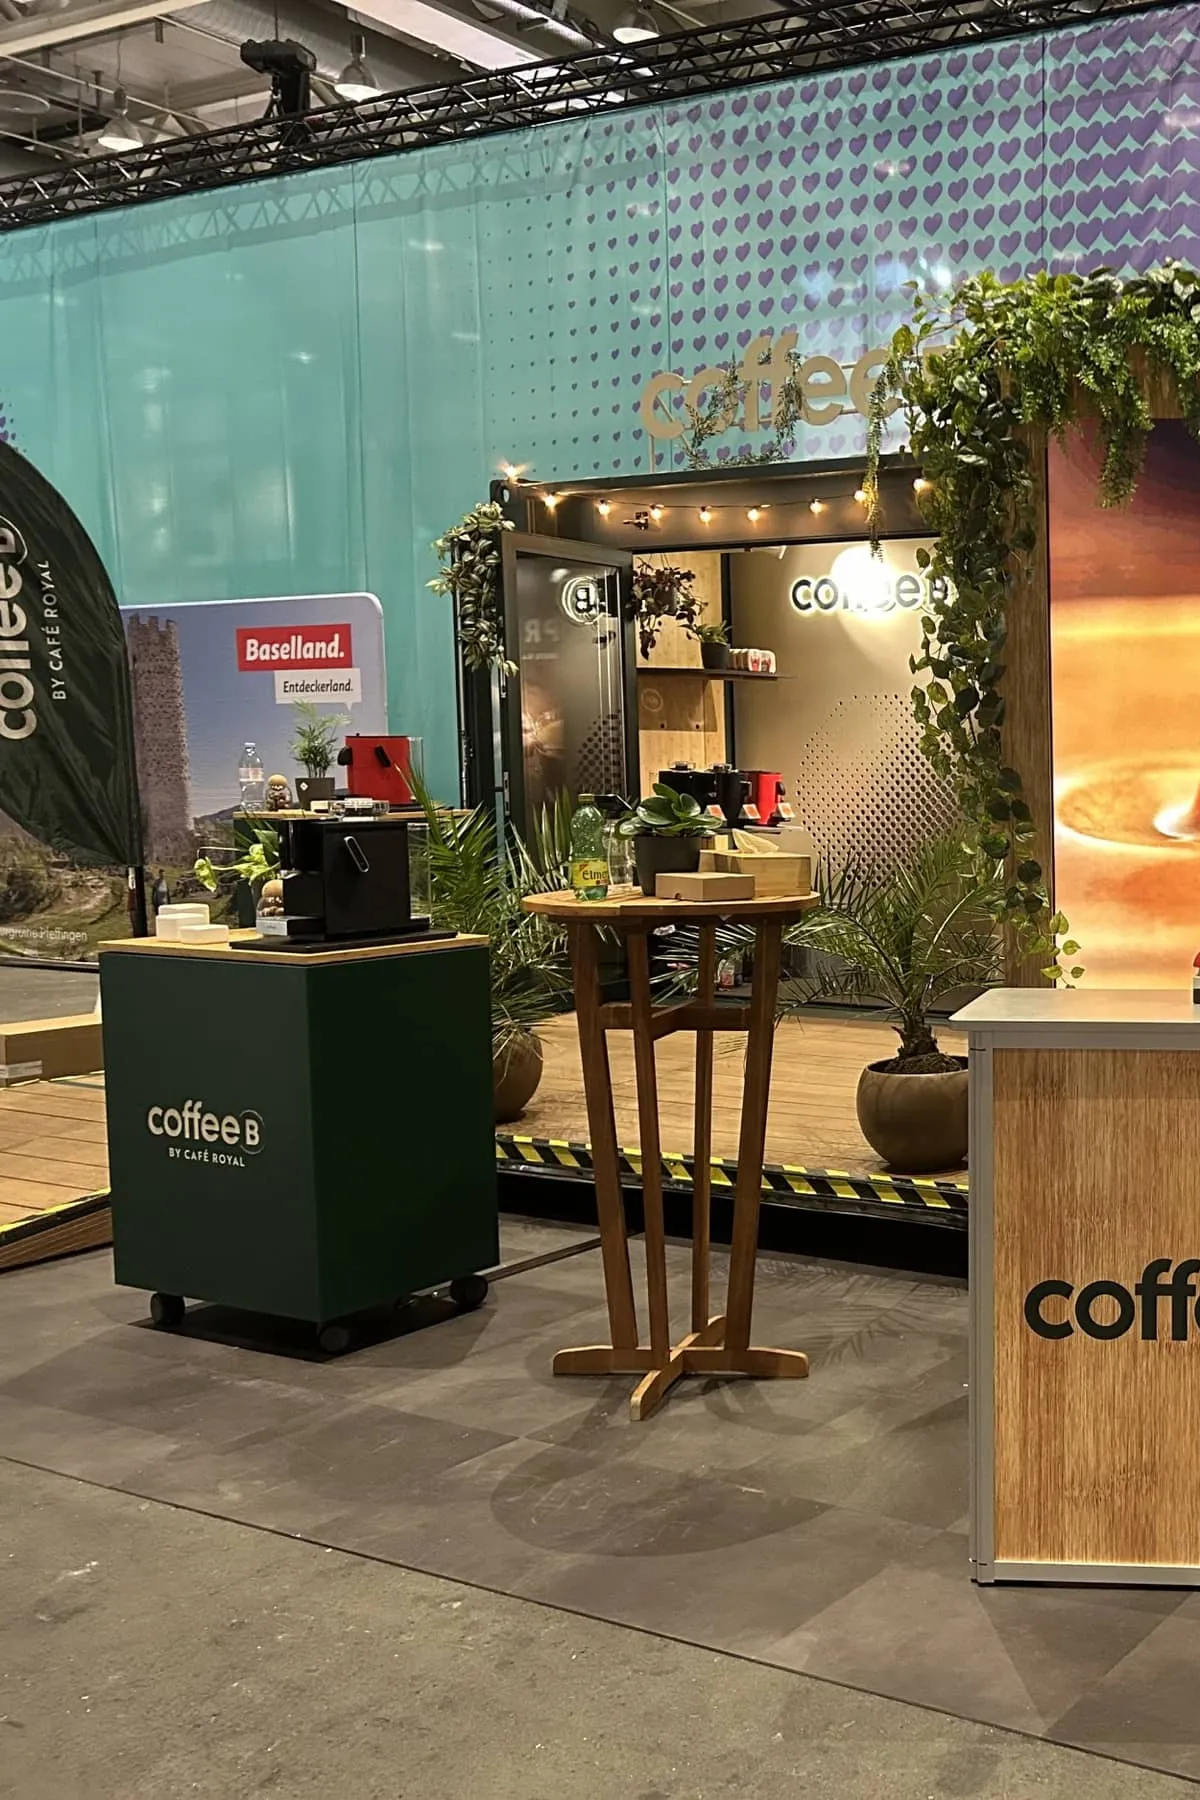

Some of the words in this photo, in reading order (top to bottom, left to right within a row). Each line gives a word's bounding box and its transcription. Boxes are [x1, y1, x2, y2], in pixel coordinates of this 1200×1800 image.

[37, 560, 59, 618] ROYAL
[40, 626, 64, 671] CAFÉ
[245, 633, 345, 661] Baselland.
[51, 678, 67, 700] BY
[283, 679, 354, 693] Entdeckerland.
[168, 1147, 181, 1158] BY
[184, 1149, 209, 1162] CAFÉ
[212, 1153, 246, 1167] ROYAL
